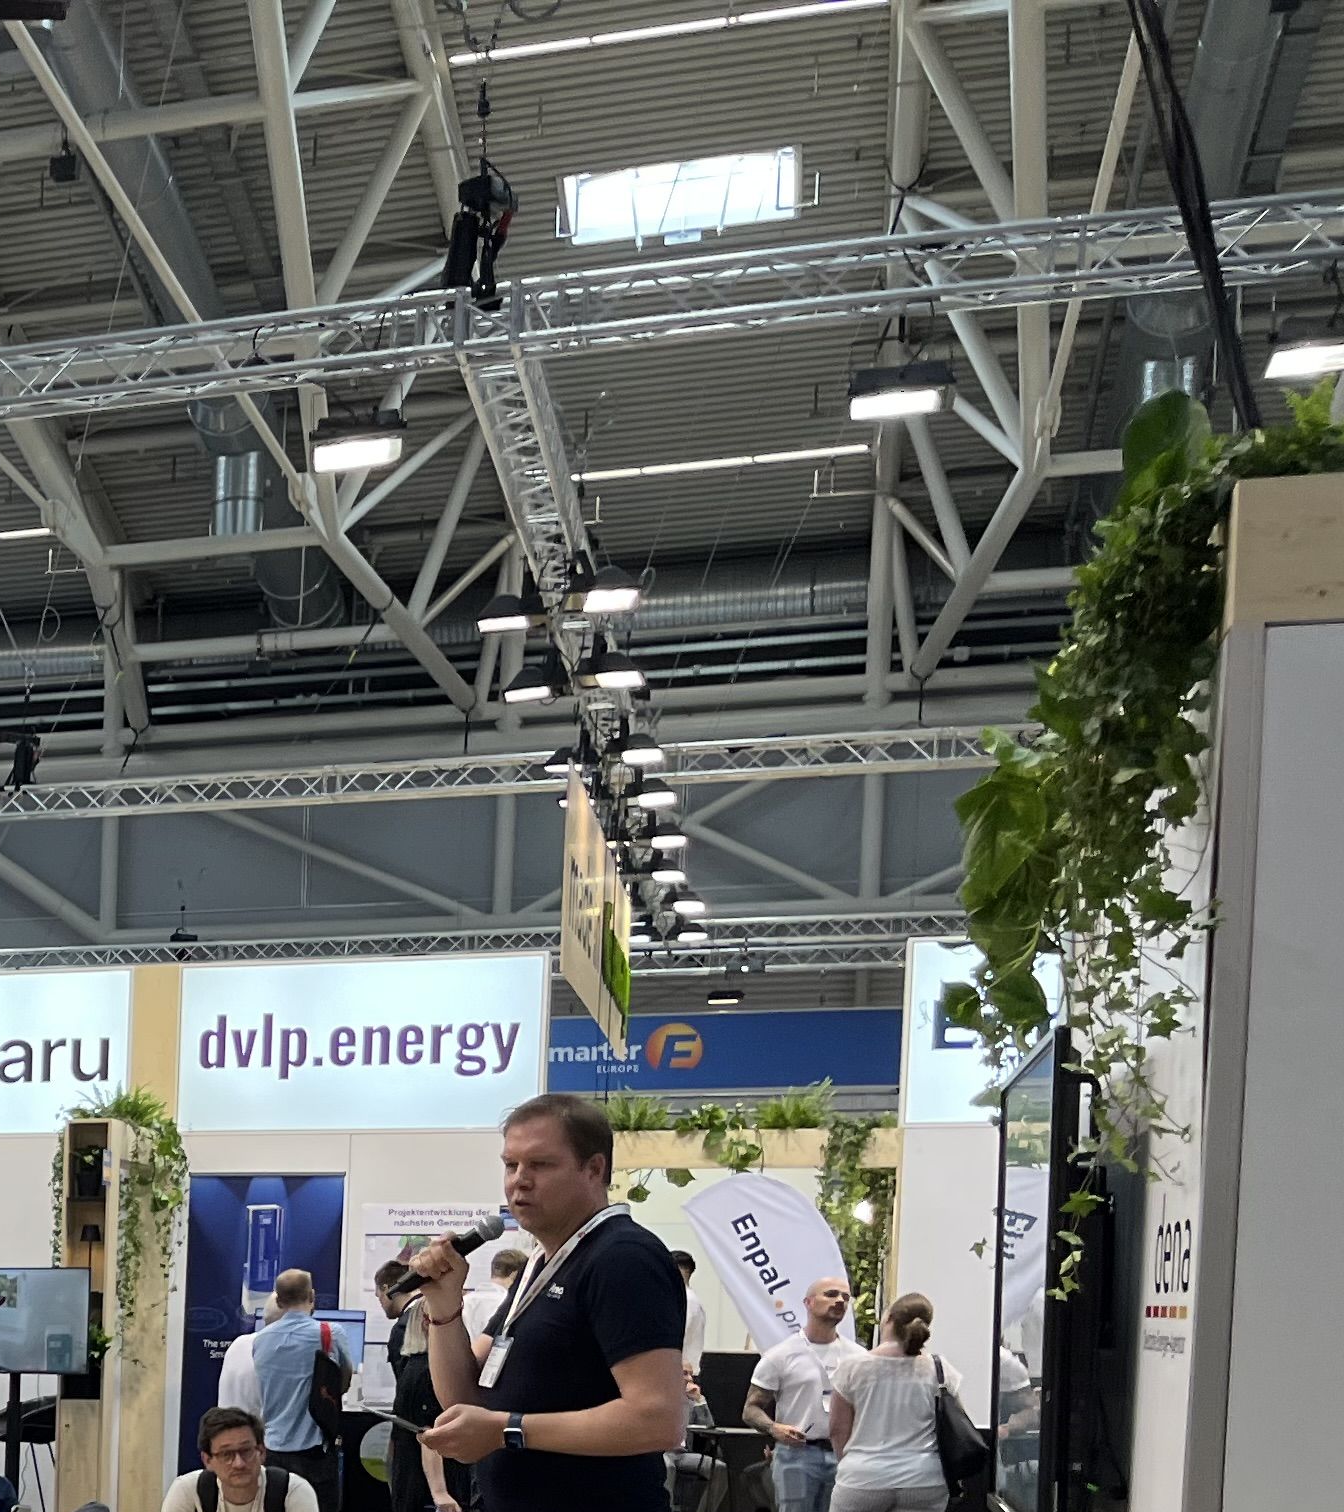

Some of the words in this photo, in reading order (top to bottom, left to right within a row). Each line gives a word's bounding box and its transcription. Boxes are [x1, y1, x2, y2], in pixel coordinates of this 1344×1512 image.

[198, 1012, 522, 1081] dvlp.energy
[596, 1064, 640, 1073] EUROPE
[1155, 1193, 1192, 1294] dena
